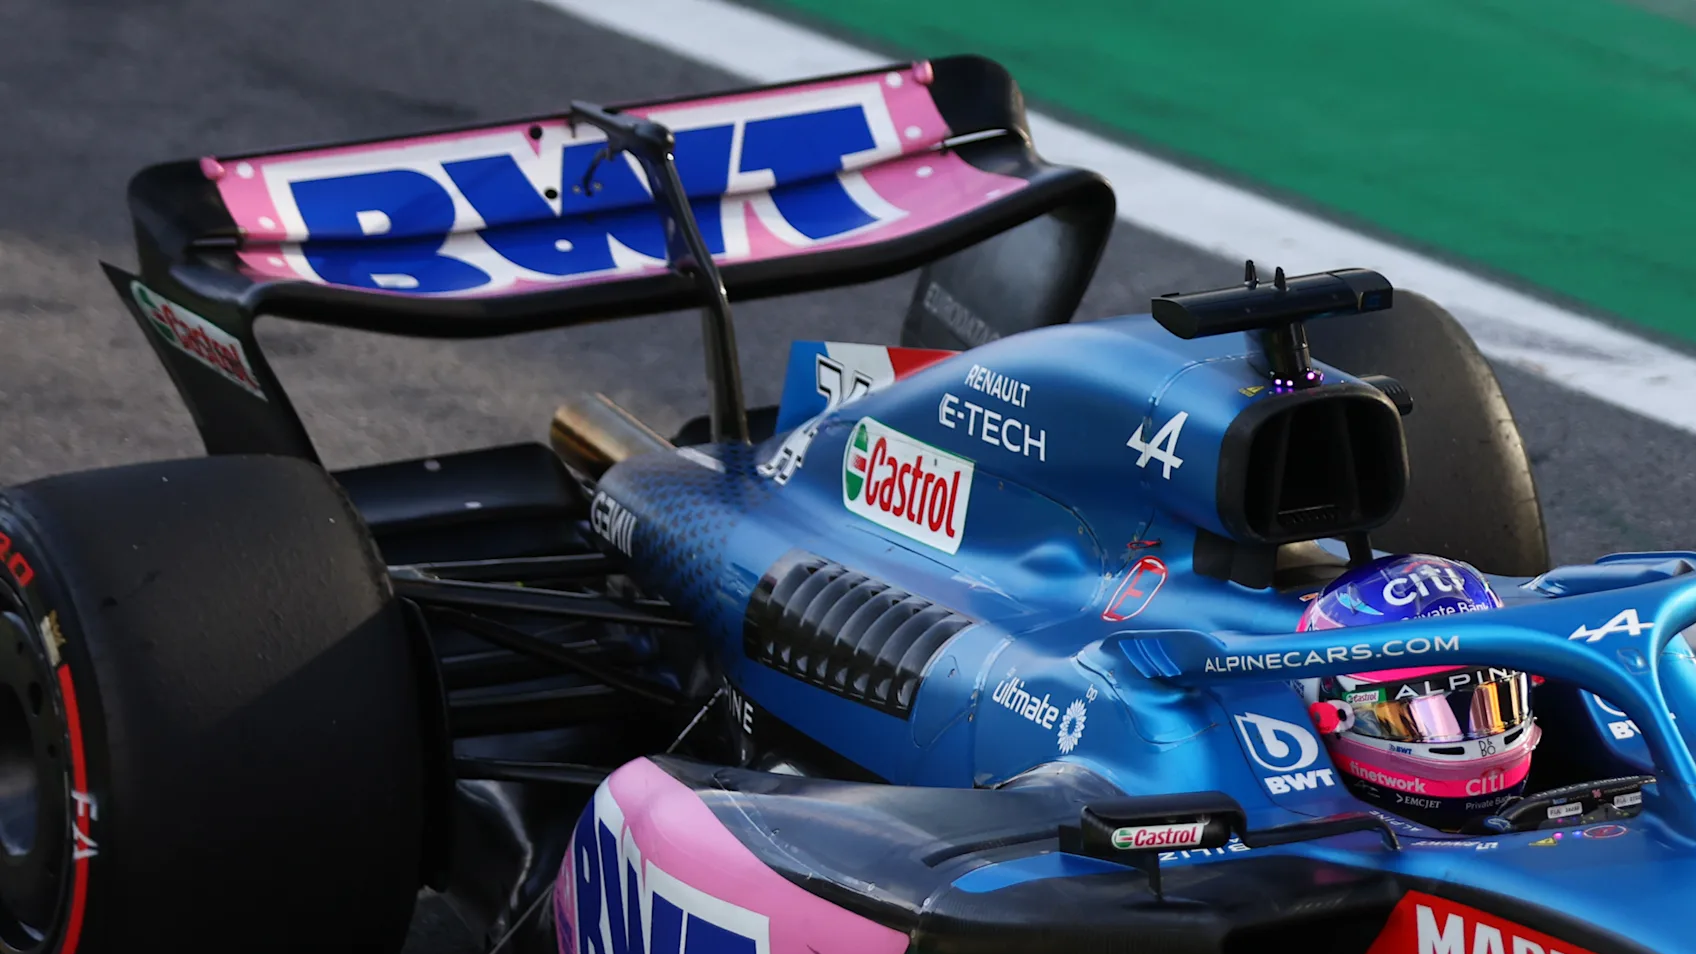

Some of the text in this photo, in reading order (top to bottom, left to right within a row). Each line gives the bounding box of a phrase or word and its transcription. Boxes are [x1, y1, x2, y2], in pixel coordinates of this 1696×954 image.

[278, 100, 892, 296] BWT
[964, 364, 1031, 409] RENAULT
[938, 392, 1047, 462] E-TECH
[864, 436, 962, 539] Castrol
[1204, 635, 1460, 673] ALPINECARS.COM
[1085, 683, 1099, 703] bp
[1395, 667, 1517, 700] ALPIN
[724, 680, 754, 735] INE
[1264, 767, 1336, 796] BWT
[1350, 760, 1427, 793] finetwork
[1465, 769, 1505, 797] citi
[1404, 796, 1442, 810] EMCJET
[1133, 825, 1199, 848] Castrol
